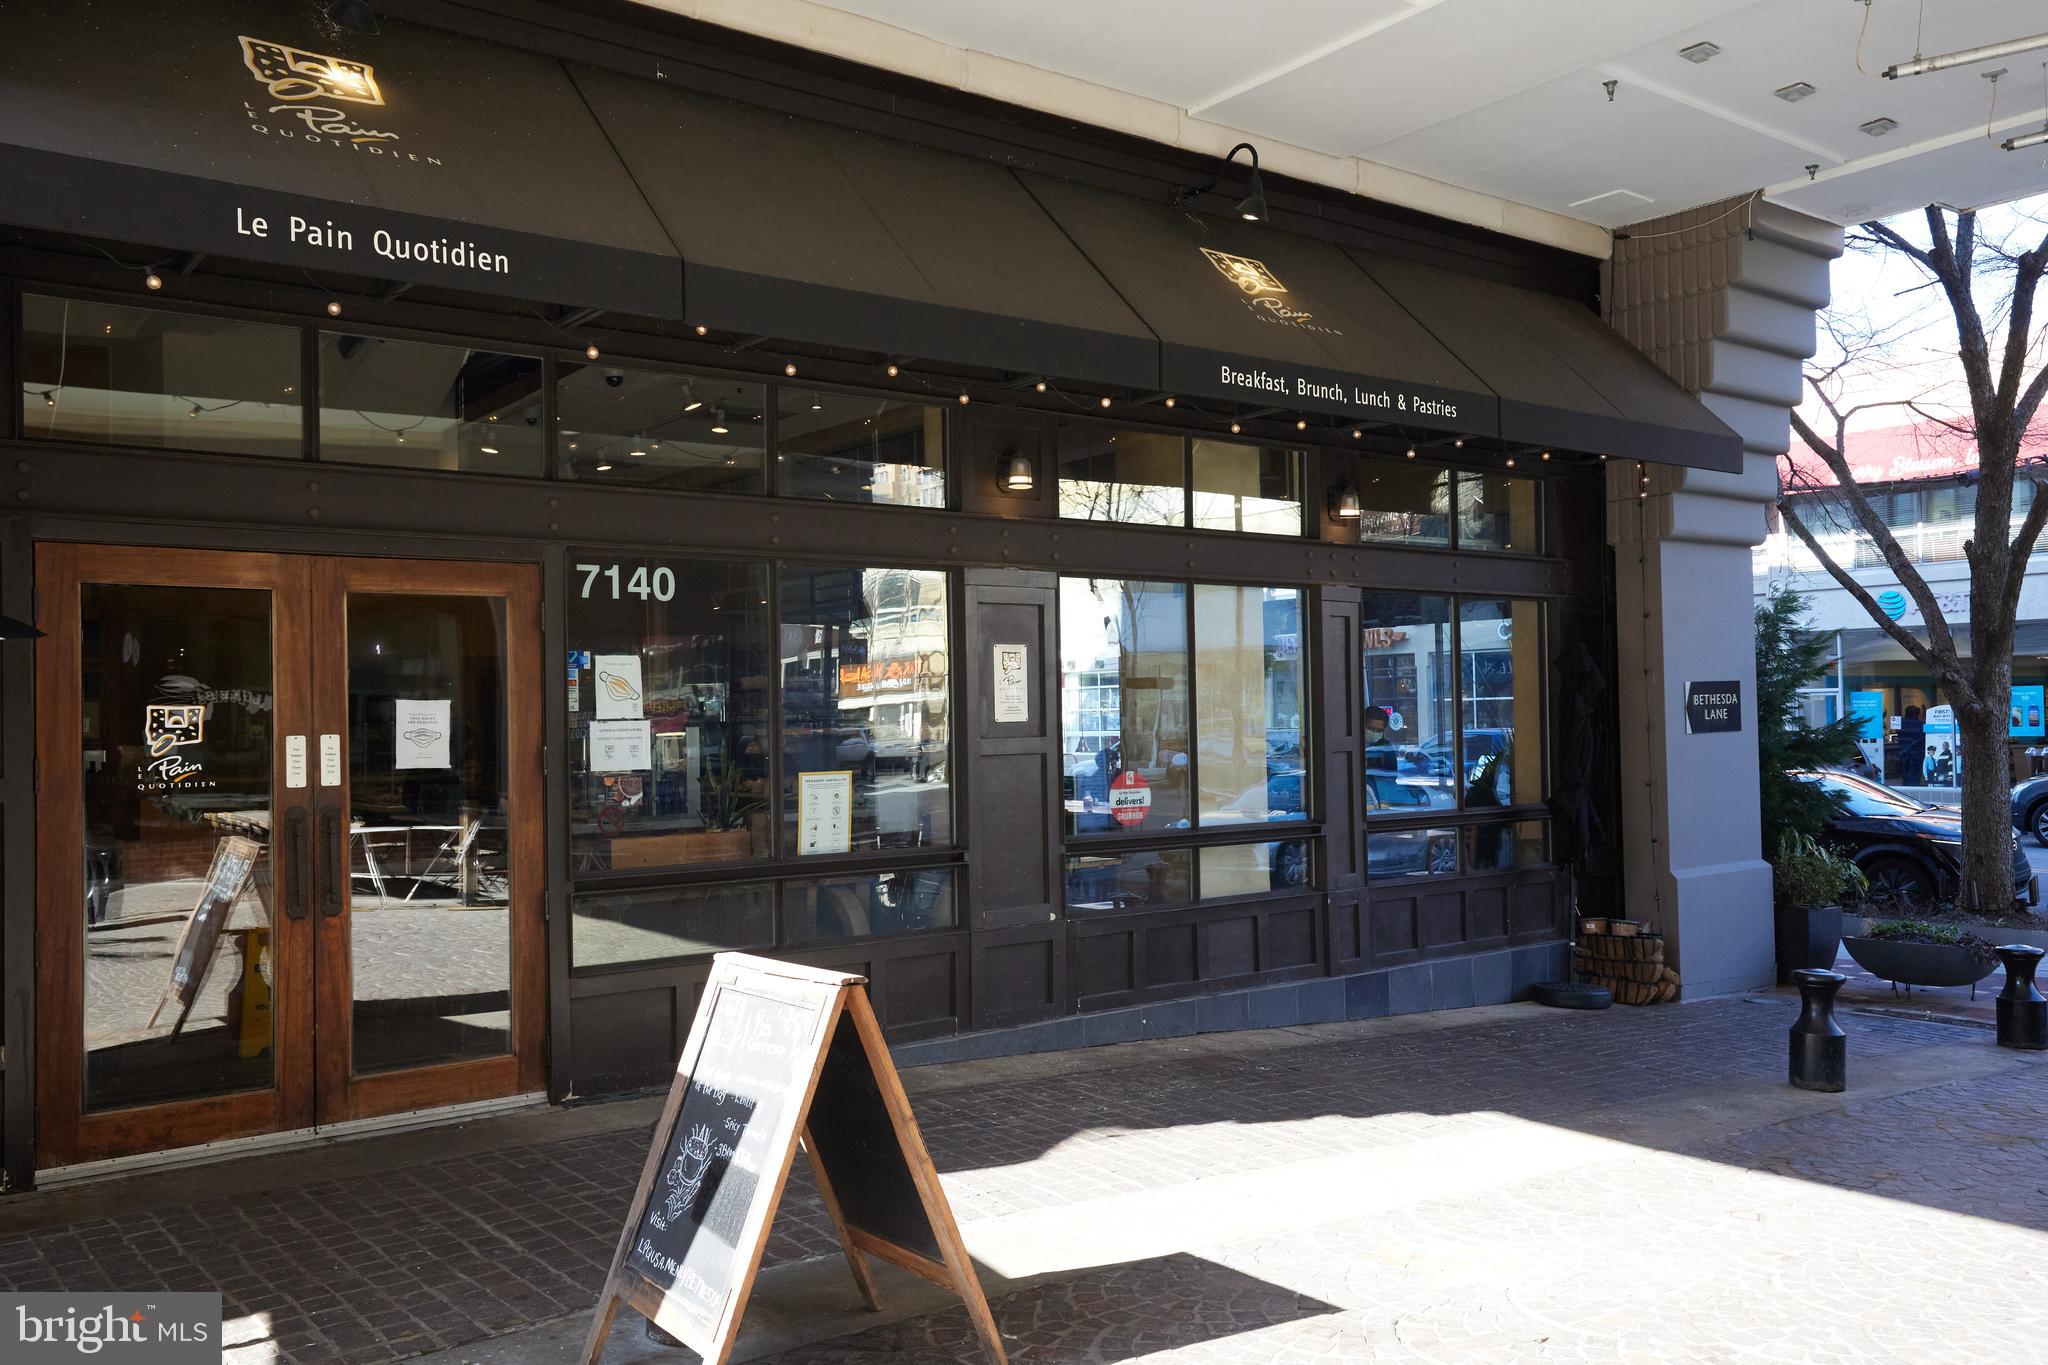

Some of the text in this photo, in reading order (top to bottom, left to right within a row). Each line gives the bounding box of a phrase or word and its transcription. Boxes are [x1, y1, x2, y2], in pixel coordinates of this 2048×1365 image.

[269, 105, 400, 140] Pain
[251, 124, 442, 166] QUOTIDIEN
[237, 207, 509, 274] Le Pain Quotidien
[1221, 365, 1457, 418] Breakfast, Brunch, Lunch & Pastries
[576, 564, 675, 601] 7140
[1693, 693, 1738, 706] BETHESDA
[1704, 708, 1728, 720] LANE
[147, 755, 202, 781] Pain
[137, 781, 216, 791] QUOTIDIEN
[1115, 796, 1145, 806] delivers!
